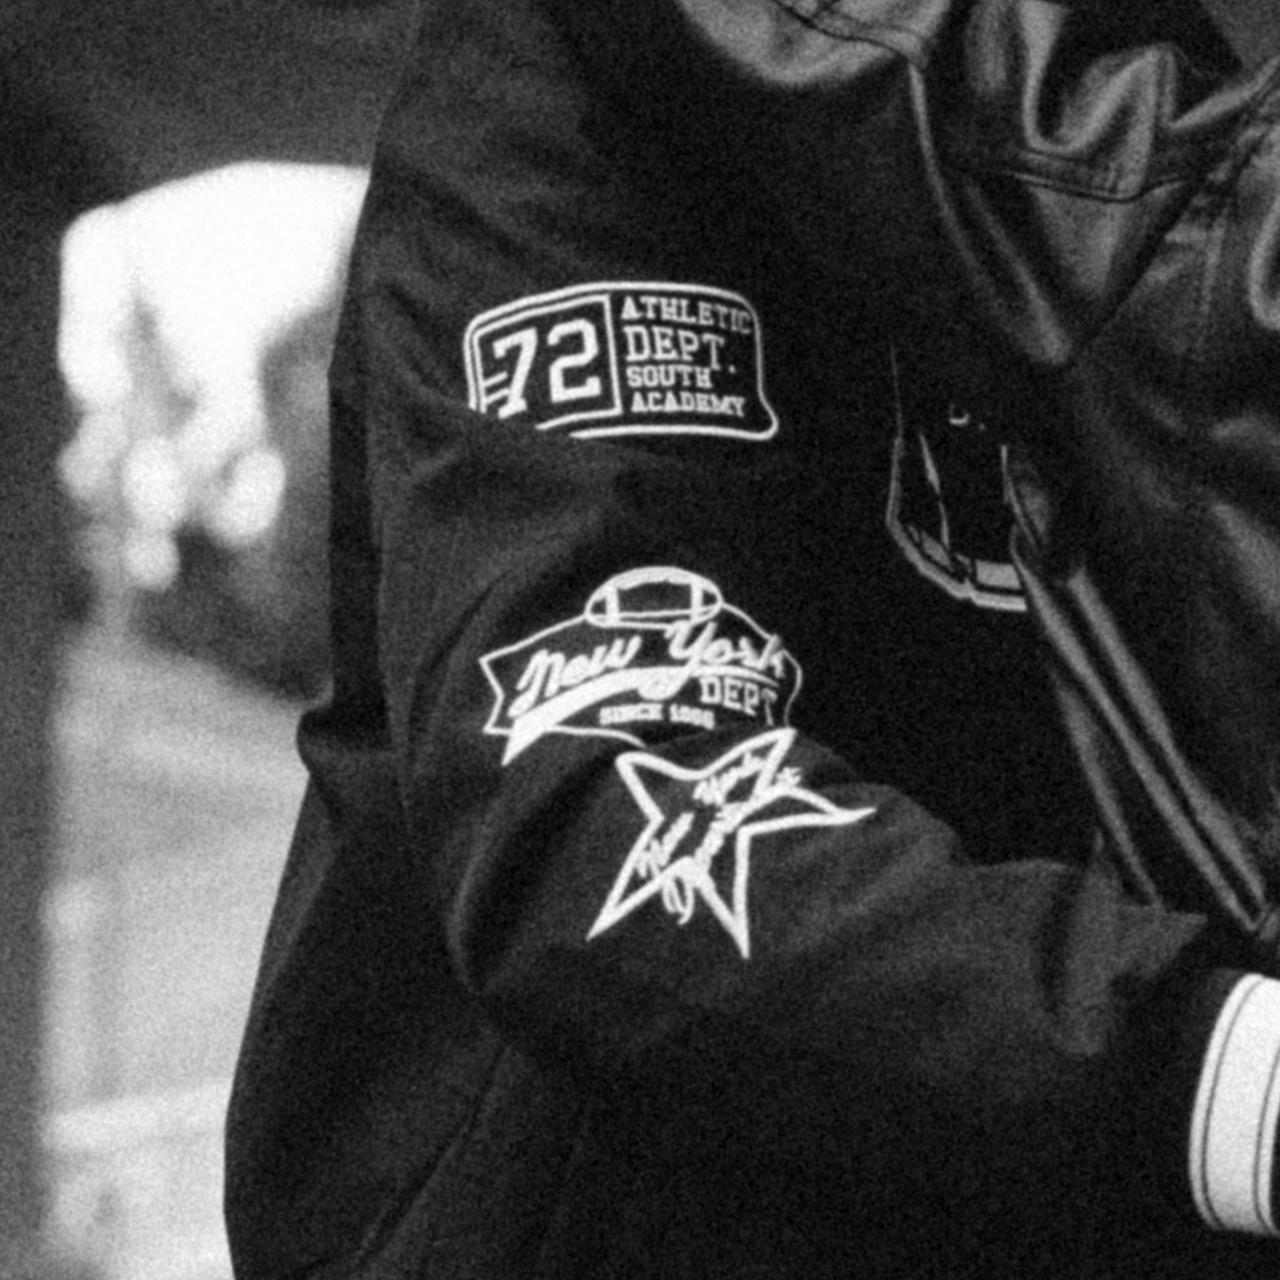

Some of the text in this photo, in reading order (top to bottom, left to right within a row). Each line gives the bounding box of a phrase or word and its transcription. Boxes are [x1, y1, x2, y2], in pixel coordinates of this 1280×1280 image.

[620, 295, 751, 335] ATHLETIC
[492, 319, 601, 420] 72
[622, 324, 737, 374] DEPT.
[626, 364, 714, 389] SOUTH
[630, 391, 746, 418] ACADEMY
[507, 618, 786, 718] New York
[699, 675, 779, 726] DEPT
